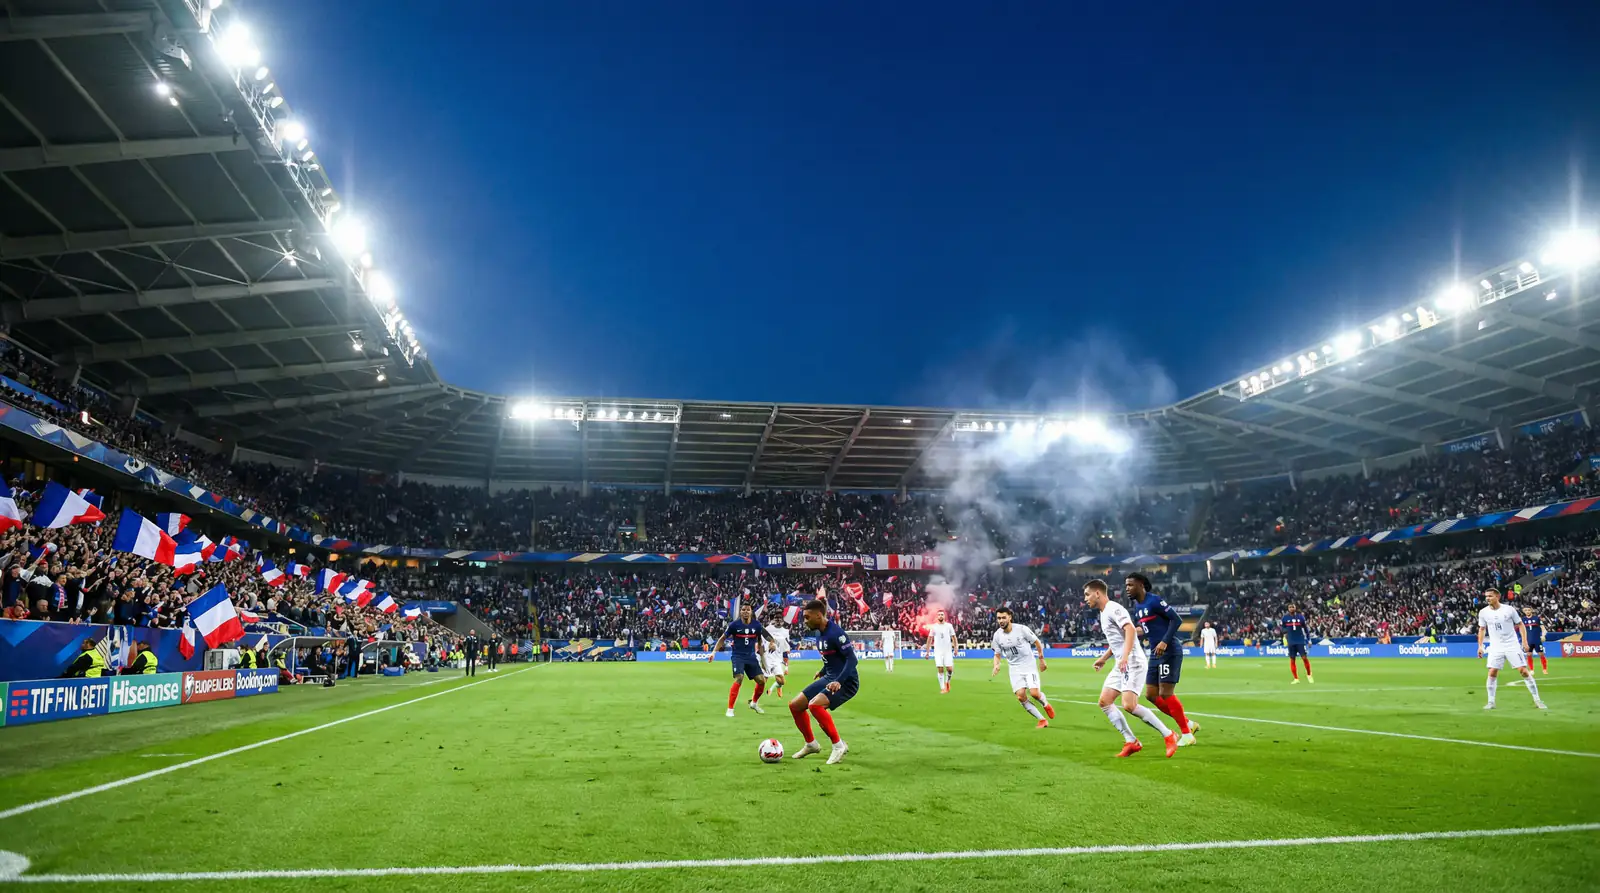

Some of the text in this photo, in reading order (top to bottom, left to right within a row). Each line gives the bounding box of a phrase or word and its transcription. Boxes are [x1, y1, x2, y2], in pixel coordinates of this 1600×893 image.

[1398, 644, 1448, 656] Booking.com
[1575, 645, 1600, 654] EUROP
[1159, 663, 1170, 675] 16
[236, 671, 277, 692] Booking.com
[111, 680, 179, 707] Hisennse
